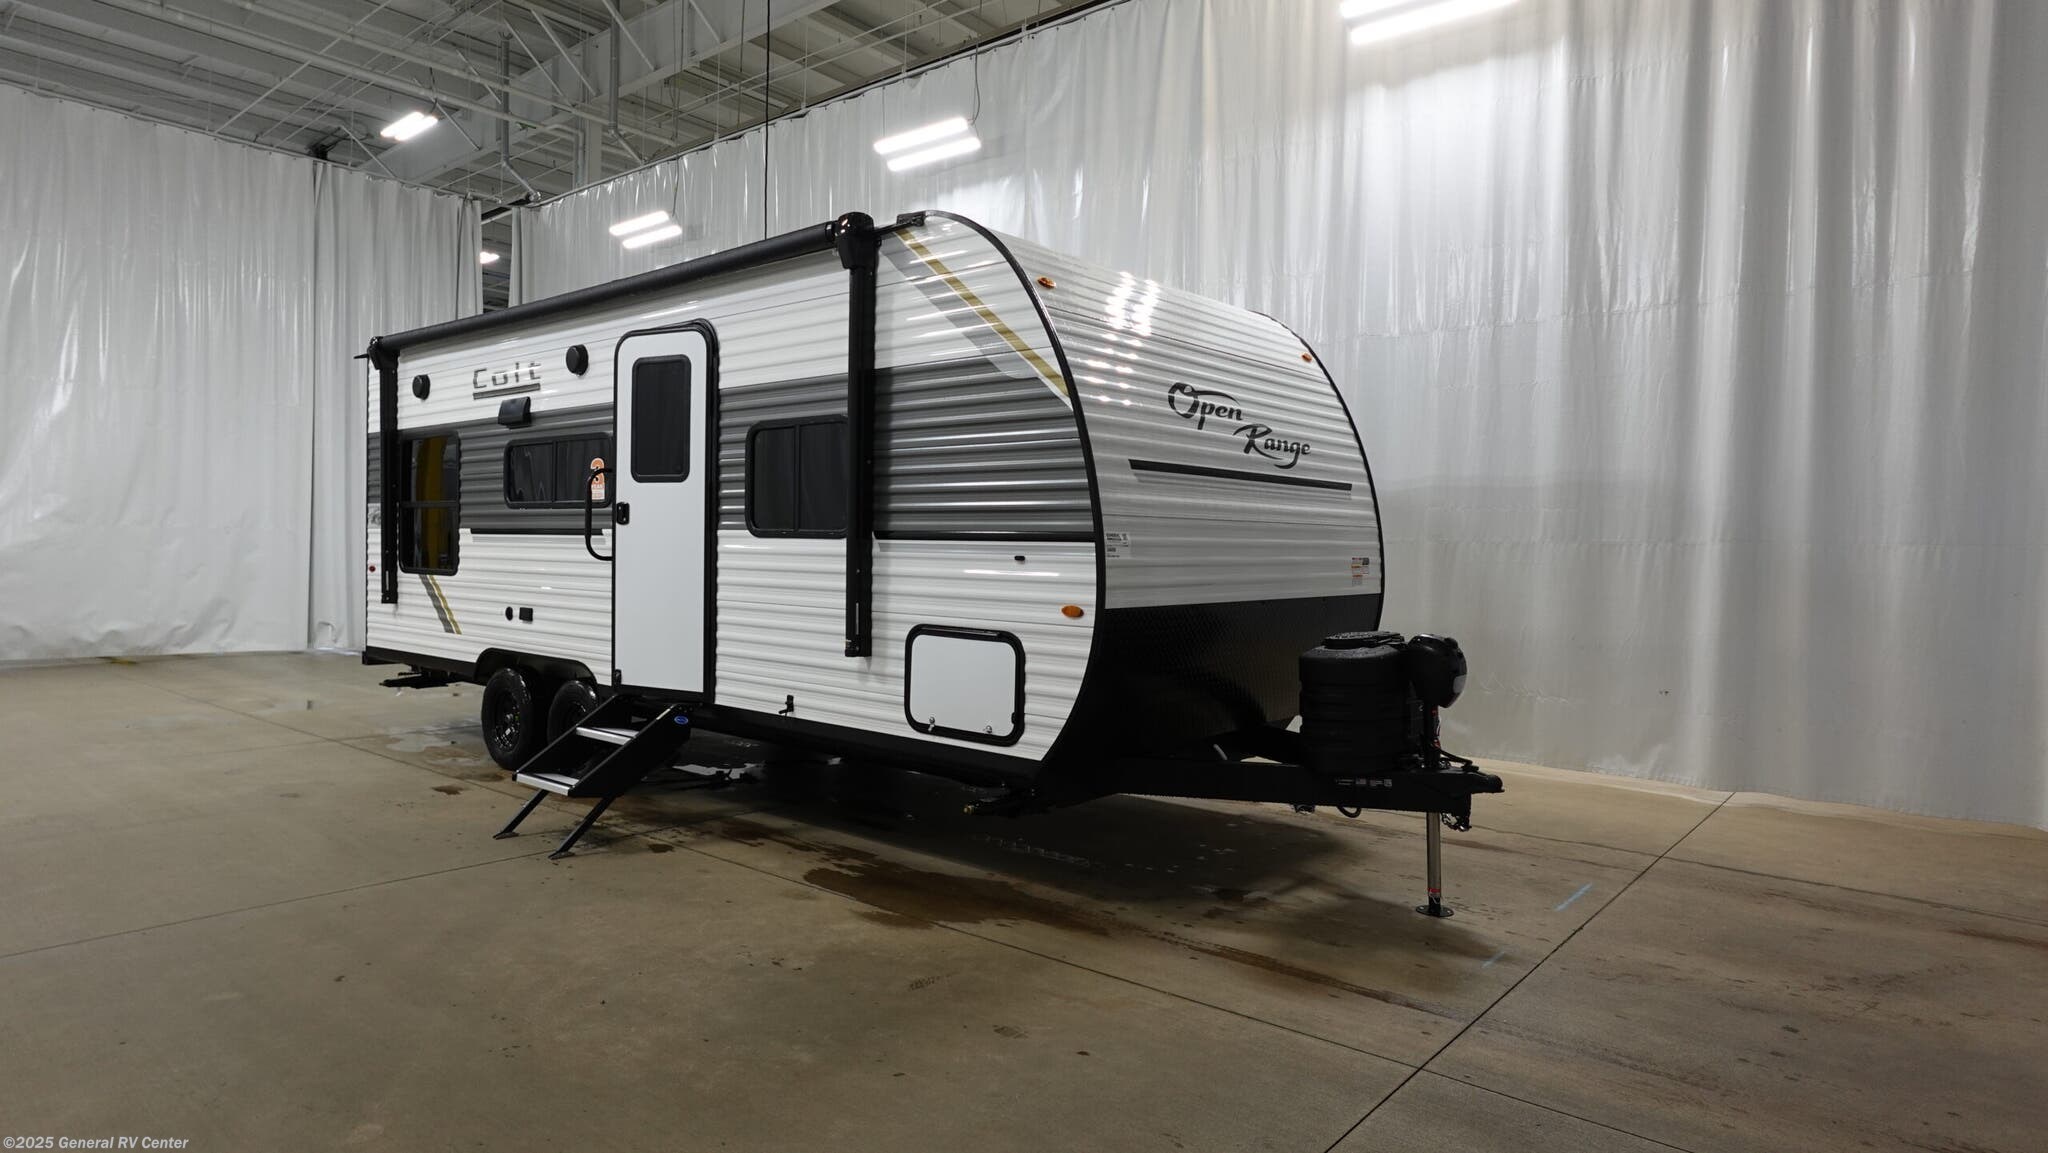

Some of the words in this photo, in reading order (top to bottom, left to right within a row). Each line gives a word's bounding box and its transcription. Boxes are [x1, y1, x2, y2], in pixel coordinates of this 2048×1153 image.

[472, 361, 542, 389] Colt
[1167, 382, 1244, 430] Open
[1232, 423, 1312, 470] Range
